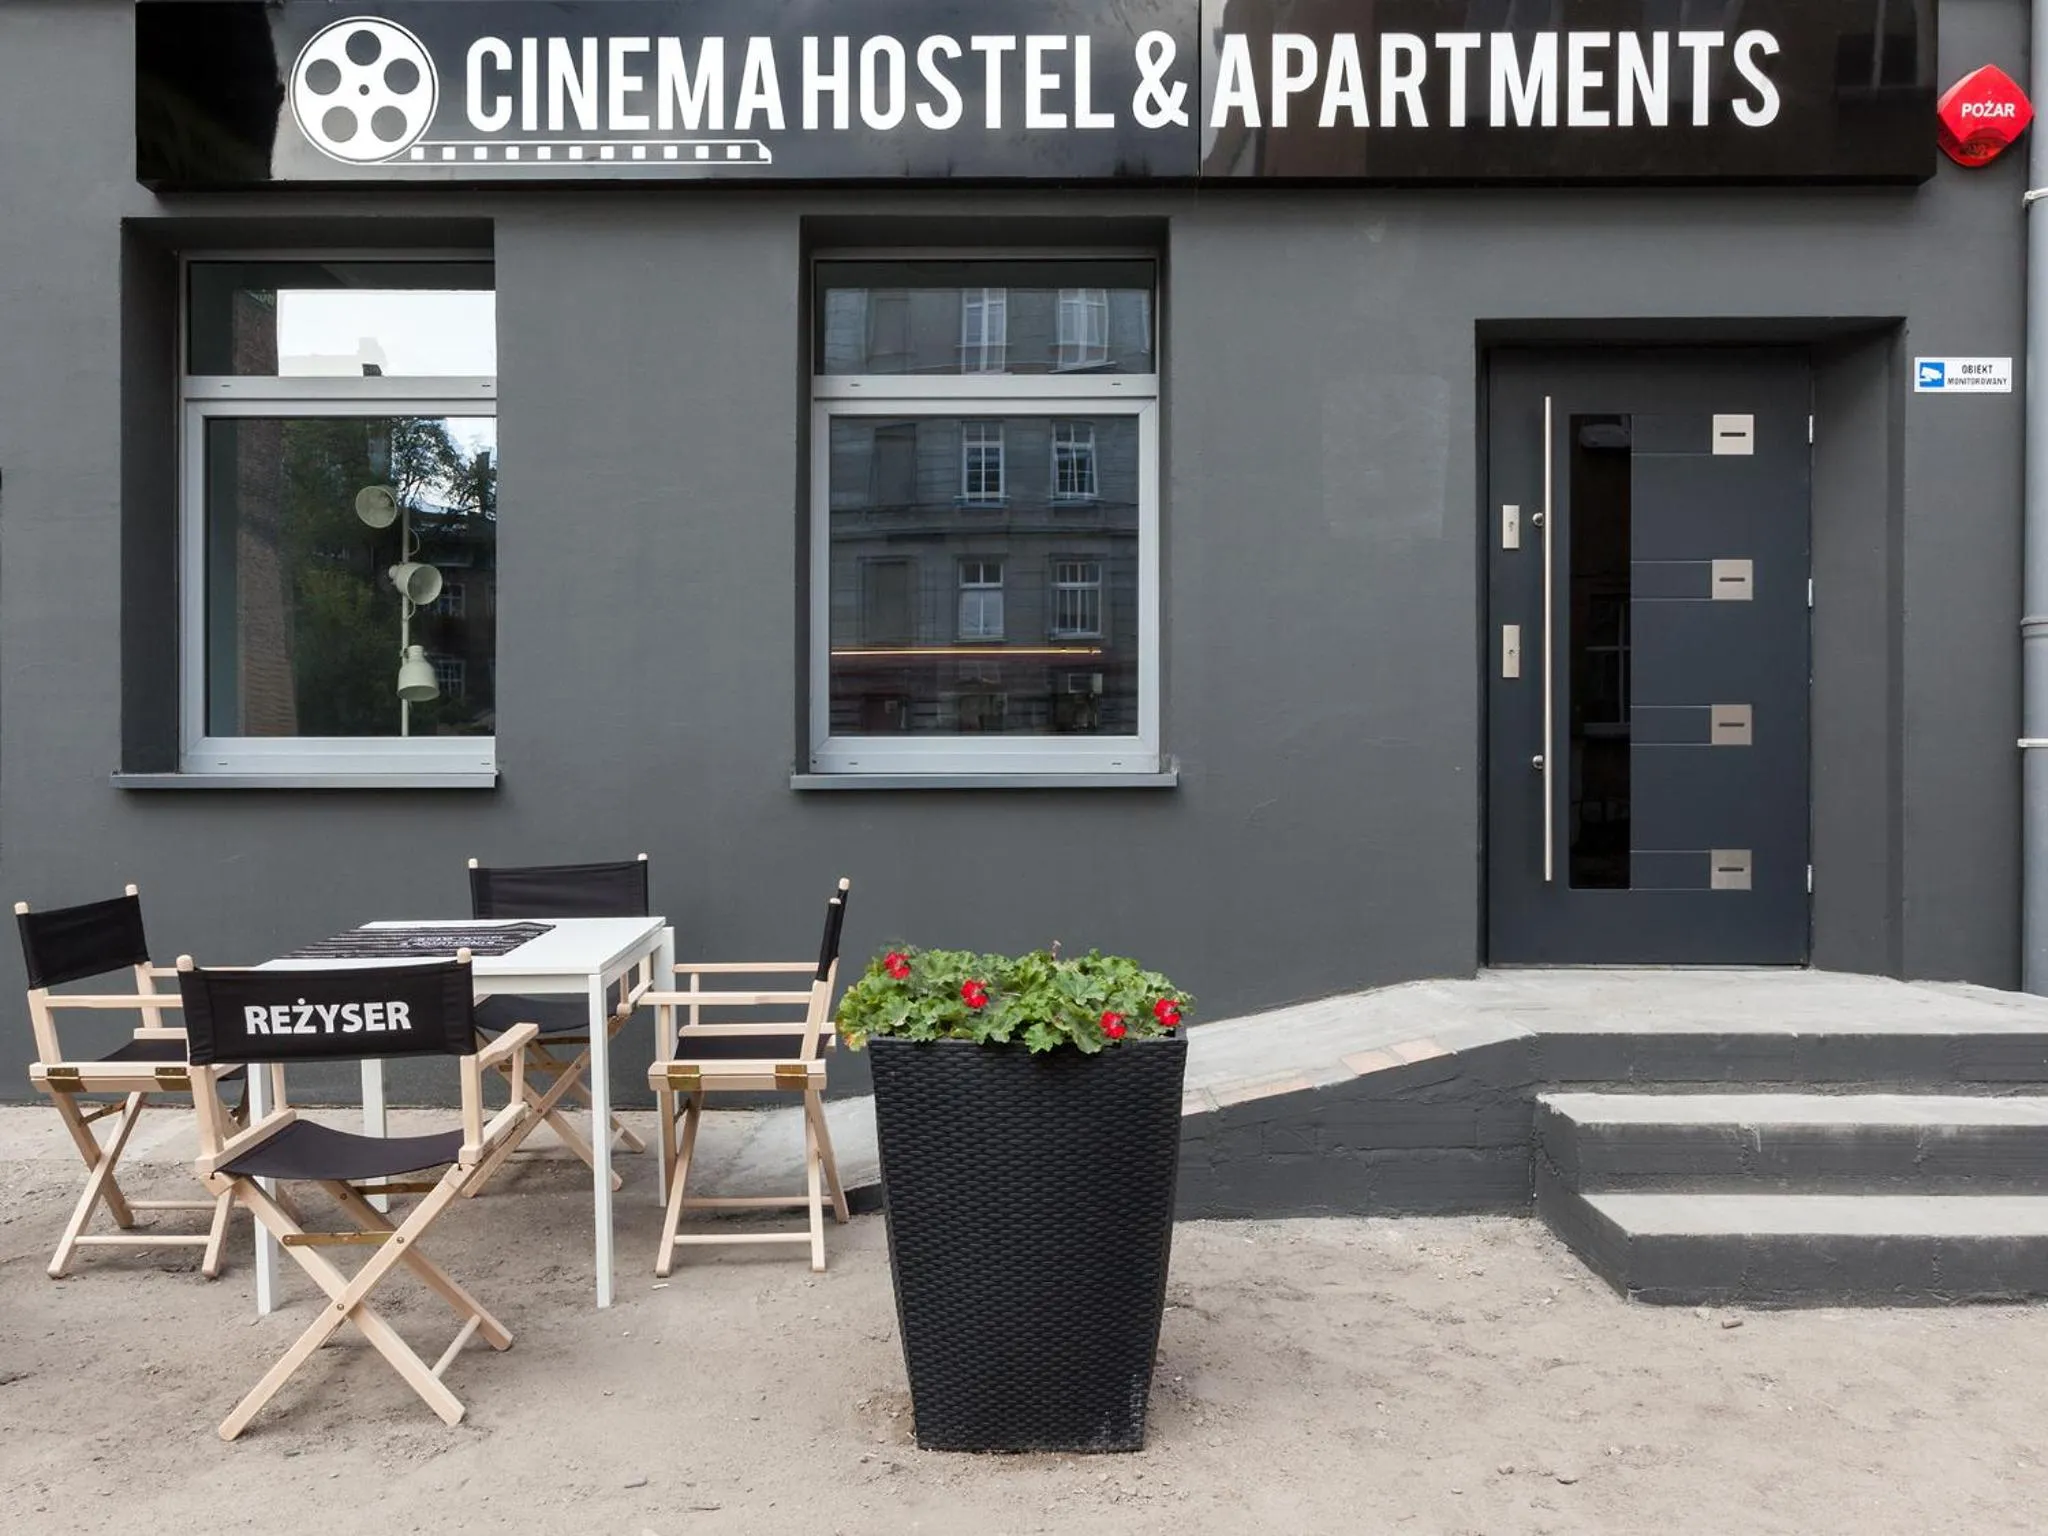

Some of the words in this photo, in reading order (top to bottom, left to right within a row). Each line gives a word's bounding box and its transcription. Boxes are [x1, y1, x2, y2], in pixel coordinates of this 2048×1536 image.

[466, 36, 786, 133] CINEMA
[802, 34, 1115, 131] HOSTEL
[1132, 30, 1189, 129] &
[1209, 29, 1781, 128] APARTMENTS
[1961, 100, 2015, 117] POŻAR
[1961, 364, 1993, 375] OBIEKT
[1947, 377, 2007, 386] MONITOROWANY
[244, 998, 412, 1035] REŻYSER
